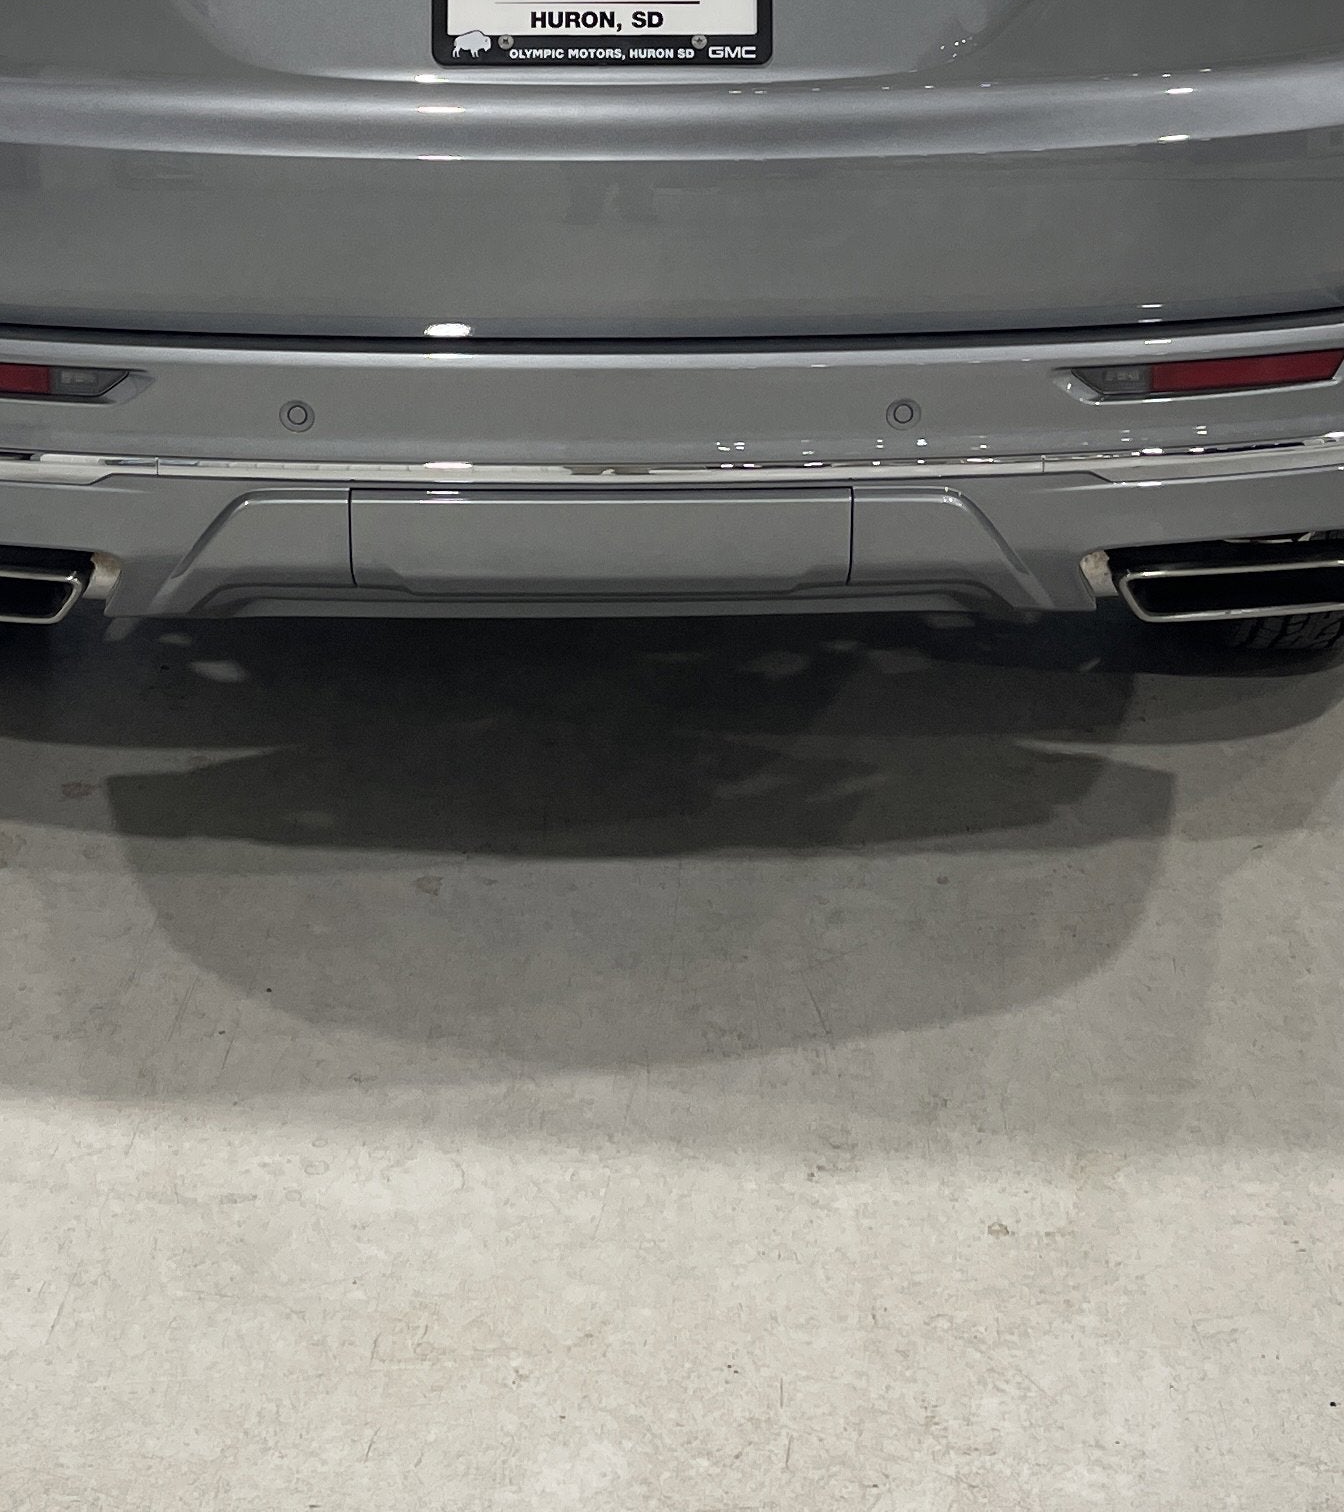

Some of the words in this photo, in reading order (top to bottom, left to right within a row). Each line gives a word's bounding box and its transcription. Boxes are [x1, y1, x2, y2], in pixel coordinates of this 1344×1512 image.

[530, 11, 622, 31] HURON,
[631, 11, 664, 28] SD
[509, 48, 564, 59] OLYMPIC
[568, 48, 626, 60] MOTORS,
[629, 48, 674, 59] HURON
[677, 48, 694, 59] SD
[708, 46, 756, 59] GMC
